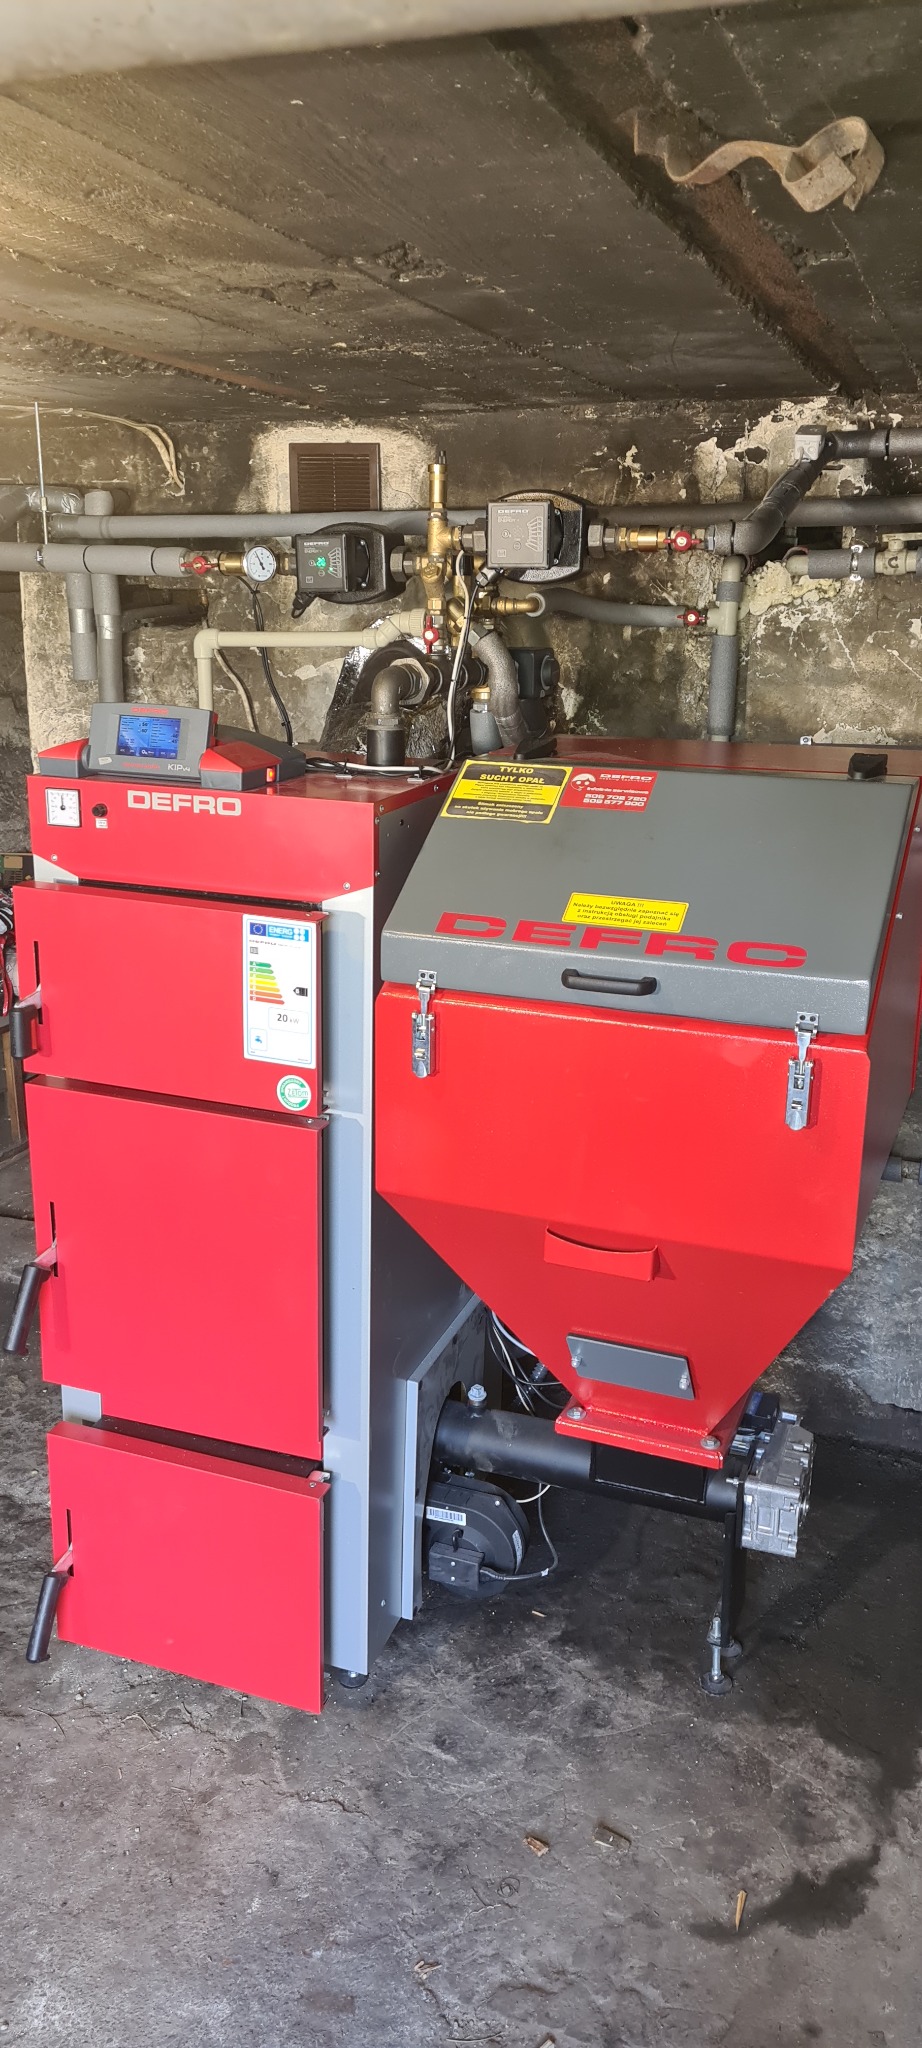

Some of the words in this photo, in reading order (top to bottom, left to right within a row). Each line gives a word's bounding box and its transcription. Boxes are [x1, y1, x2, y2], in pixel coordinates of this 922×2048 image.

[500, 766, 534, 774] TYLKO
[480, 774, 517, 782] SUCHY
[518, 776, 545, 784] OPAŁ
[127, 790, 242, 816] DEFRO
[572, 902, 594, 910] Należy
[594, 904, 637, 913] bezwzględnie
[582, 908, 613, 917] instrukcją
[591, 915, 632, 923] przestrzegać
[268, 926, 294, 936] ENERG
[434, 911, 808, 968] DEFRO
[277, 1013, 288, 1022] 20
